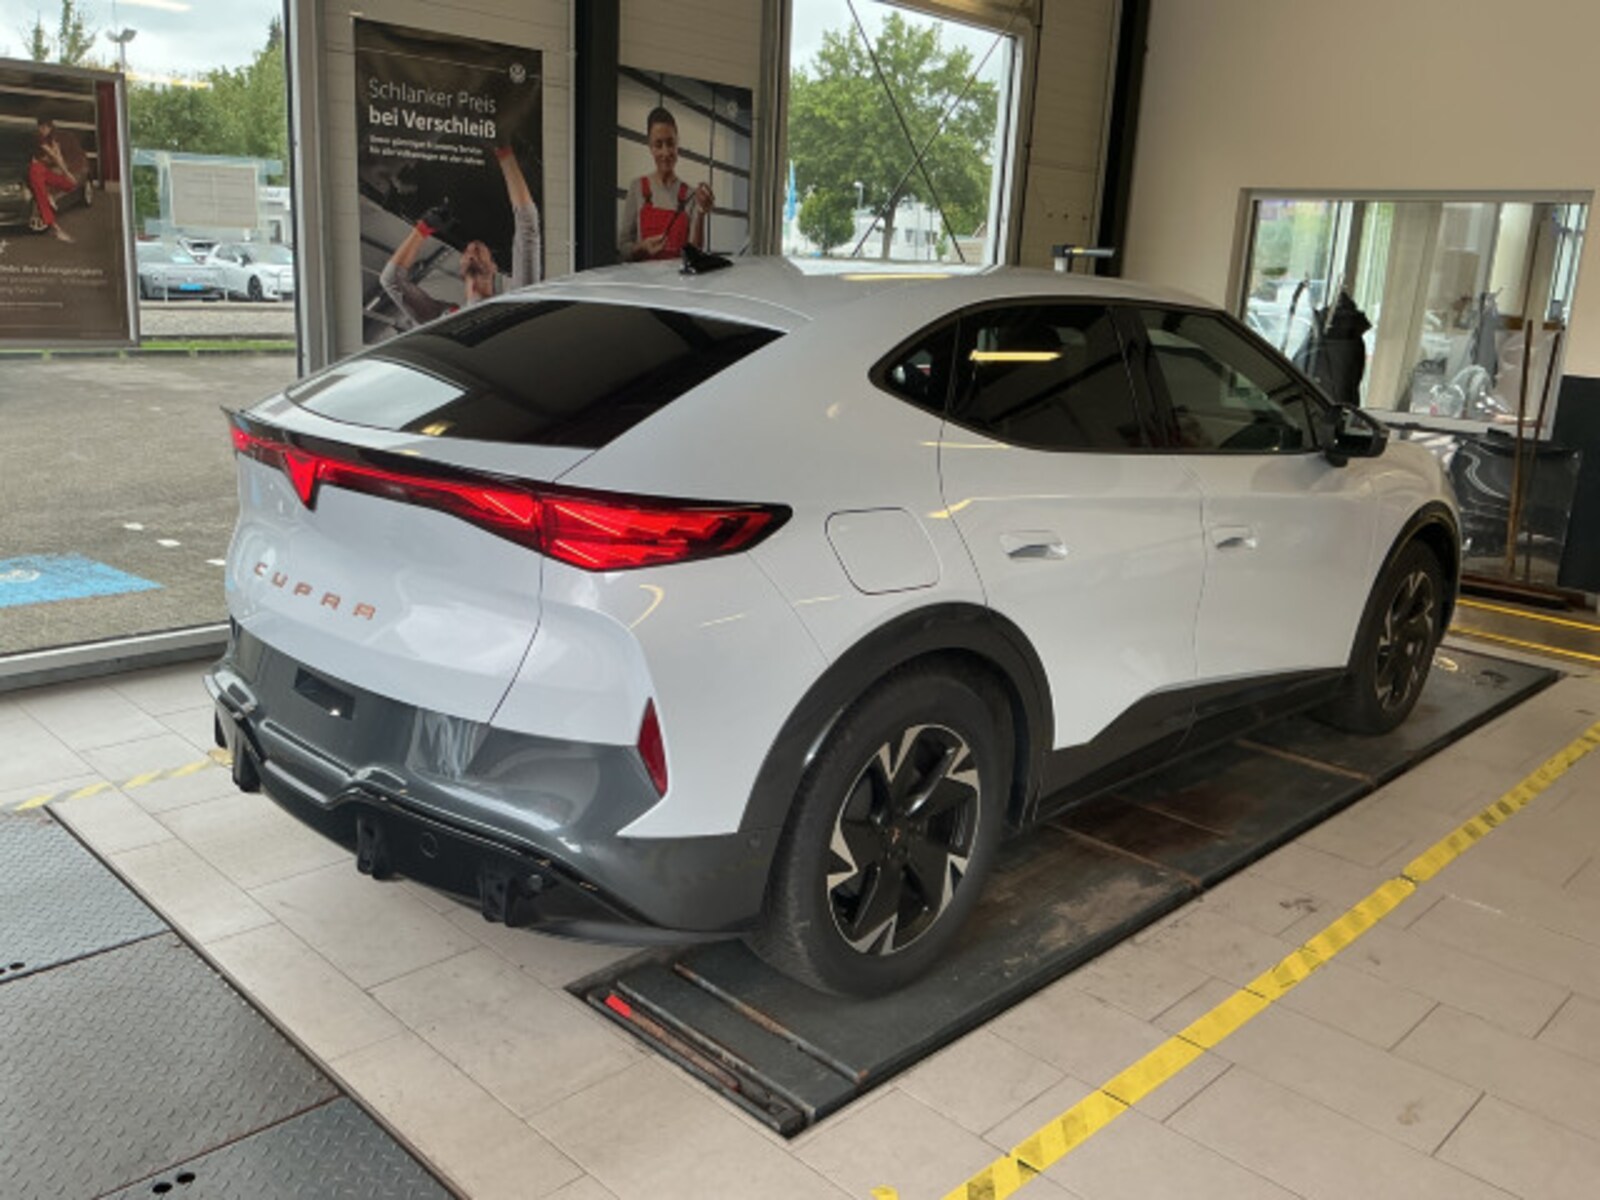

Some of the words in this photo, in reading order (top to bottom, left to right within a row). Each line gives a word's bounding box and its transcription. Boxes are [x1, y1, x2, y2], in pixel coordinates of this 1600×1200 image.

[368, 77, 453, 108] Schlanker
[457, 91, 496, 113] Preis
[369, 104, 398, 126] bei
[402, 109, 496, 138] Verschleiß
[254, 562, 376, 620] CUPRA
